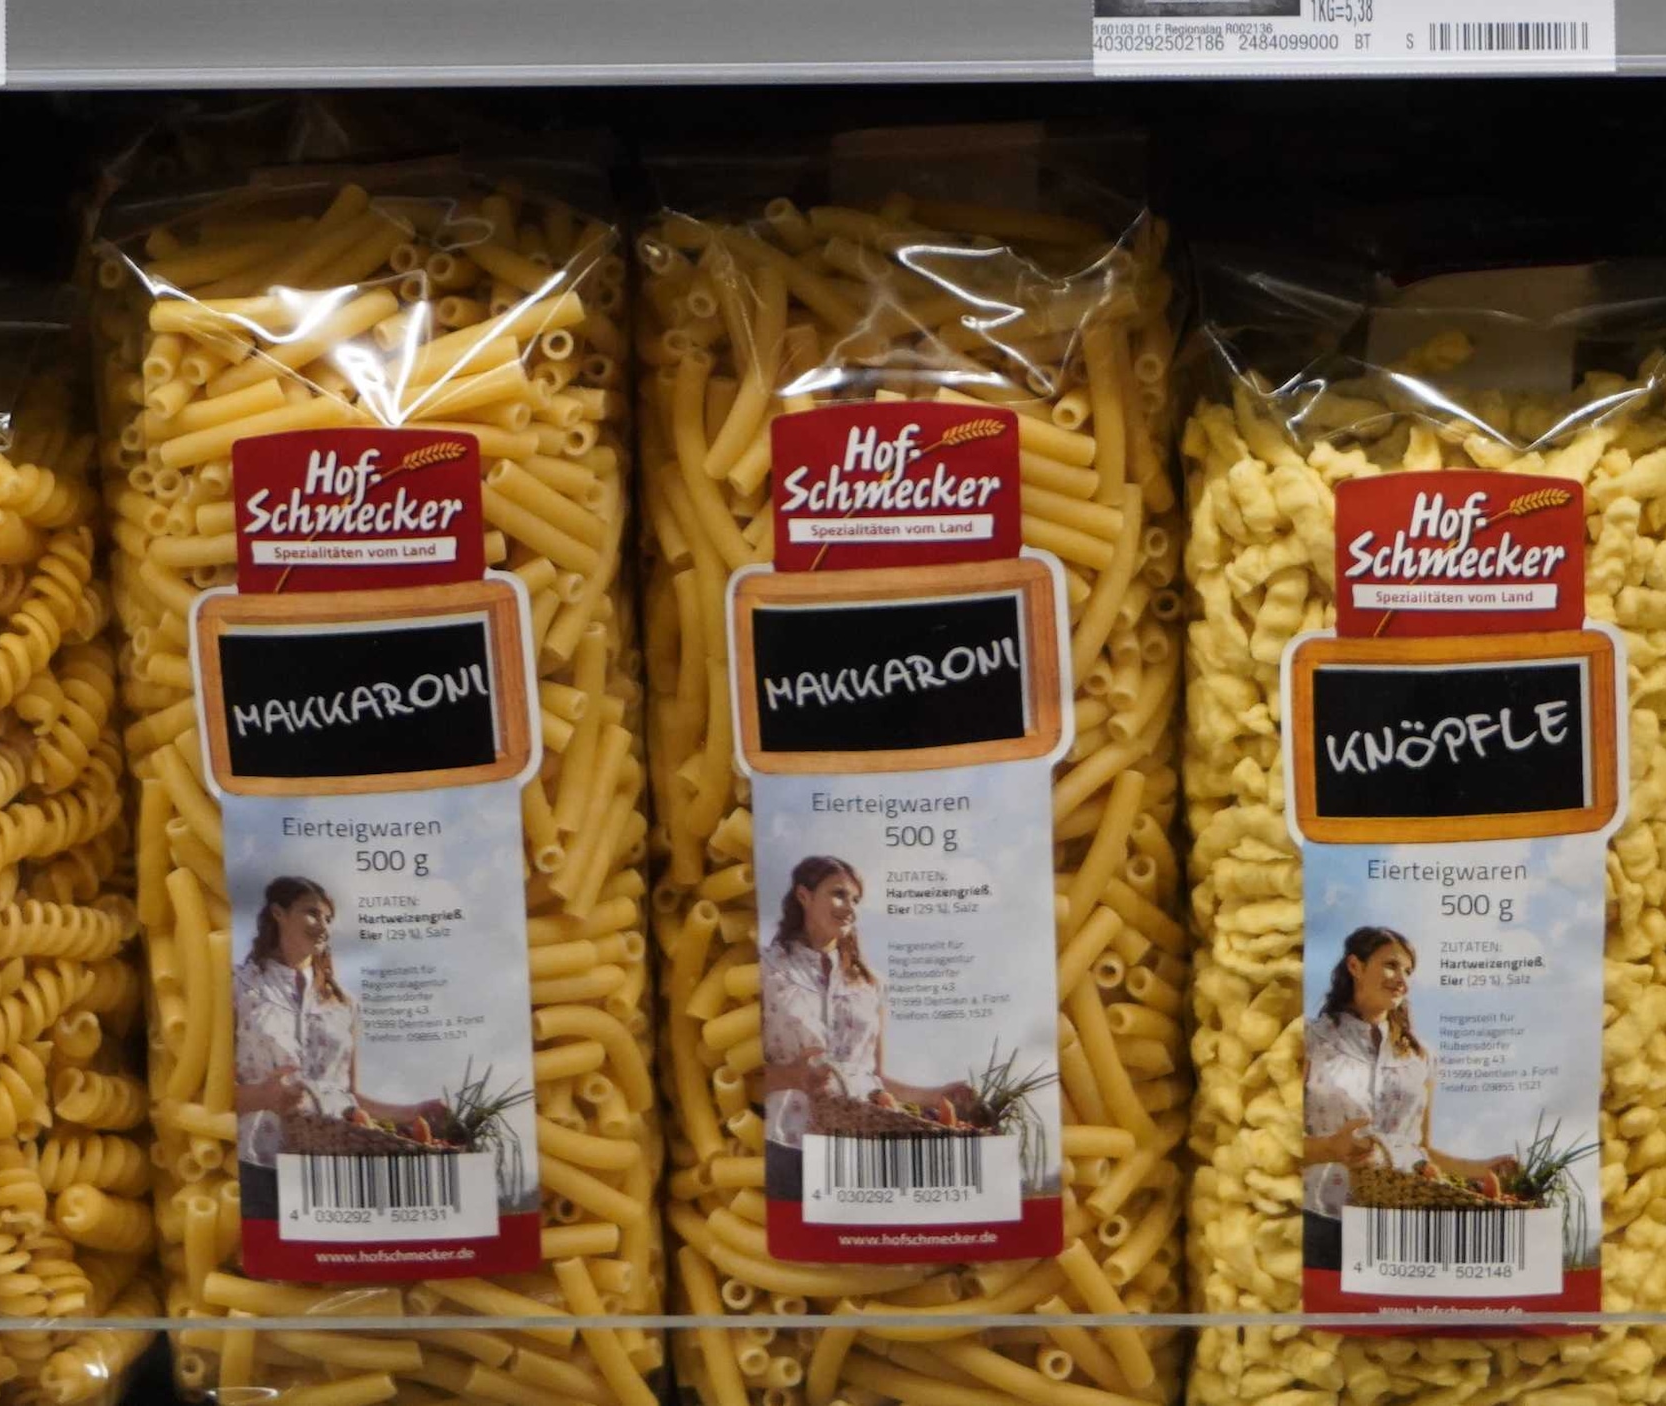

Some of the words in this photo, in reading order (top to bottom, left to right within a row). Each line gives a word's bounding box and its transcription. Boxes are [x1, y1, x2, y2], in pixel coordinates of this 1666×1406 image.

[1094, 34, 1225, 52] 4030292502186
[1238, 34, 1339, 51] 2484099000
[1354, 33, 1370, 49] BT
[1406, 33, 1414, 49] S
[843, 424, 921, 485] Hof-
[305, 449, 381, 509] Hof-
[780, 464, 1001, 512] Schmecker
[244, 487, 463, 534] Schmecker
[1409, 492, 1487, 553] Hof-
[1345, 530, 1565, 578] Schmecker
[764, 636, 1019, 710] MAKKARONI
[234, 663, 489, 738] MAKKARONI
[1326, 700, 1568, 775] KNÖPFLE
[282, 817, 442, 842] Eierteigwaren
[812, 793, 970, 819] Eierteigwaren
[356, 850, 405, 872] 500
[414, 853, 429, 876] g
[1367, 860, 1527, 885] Eierteigwaren
[1353, 1262, 1362, 1273] 4
[1380, 1264, 1436, 1278] 030292
[1456, 1264, 1512, 1278] 502148
